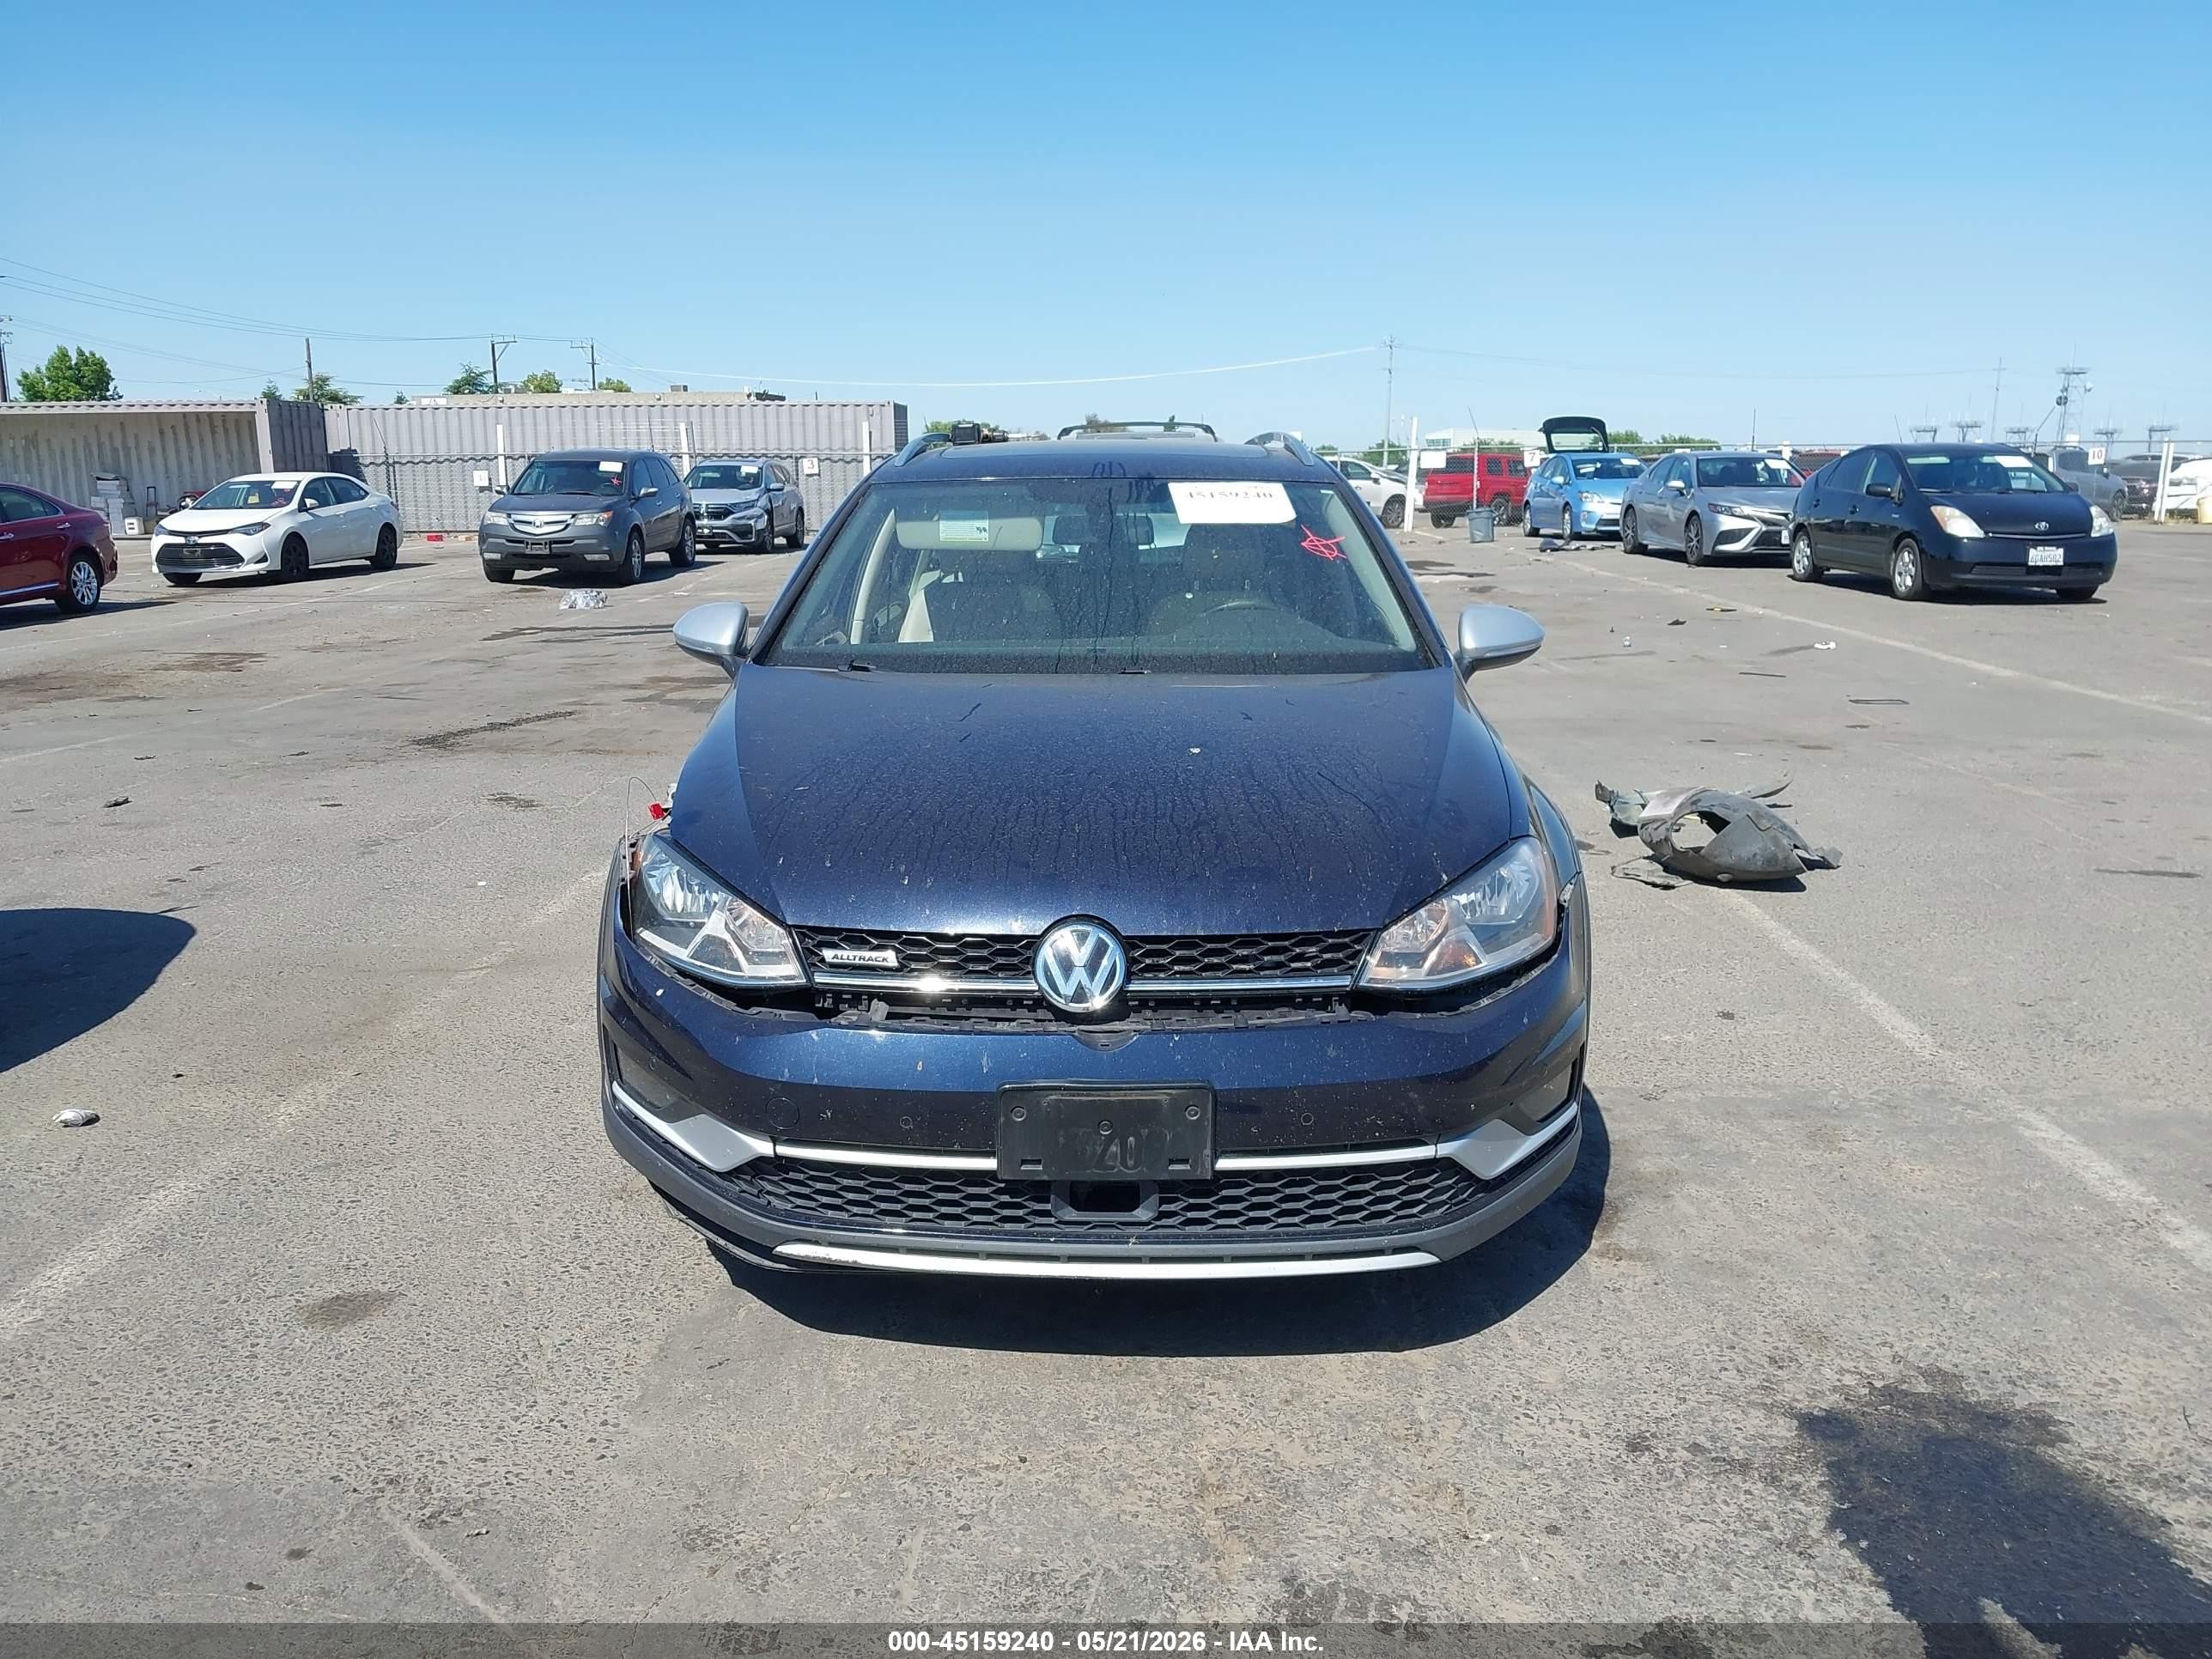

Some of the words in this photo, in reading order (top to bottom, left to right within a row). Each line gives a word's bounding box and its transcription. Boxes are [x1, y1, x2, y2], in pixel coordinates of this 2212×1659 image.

[1528, 452, 1536, 462] 7
[2092, 449, 2103, 460] 10
[807, 459, 815, 470] 3
[831, 953, 889, 963] ALLTRACK
